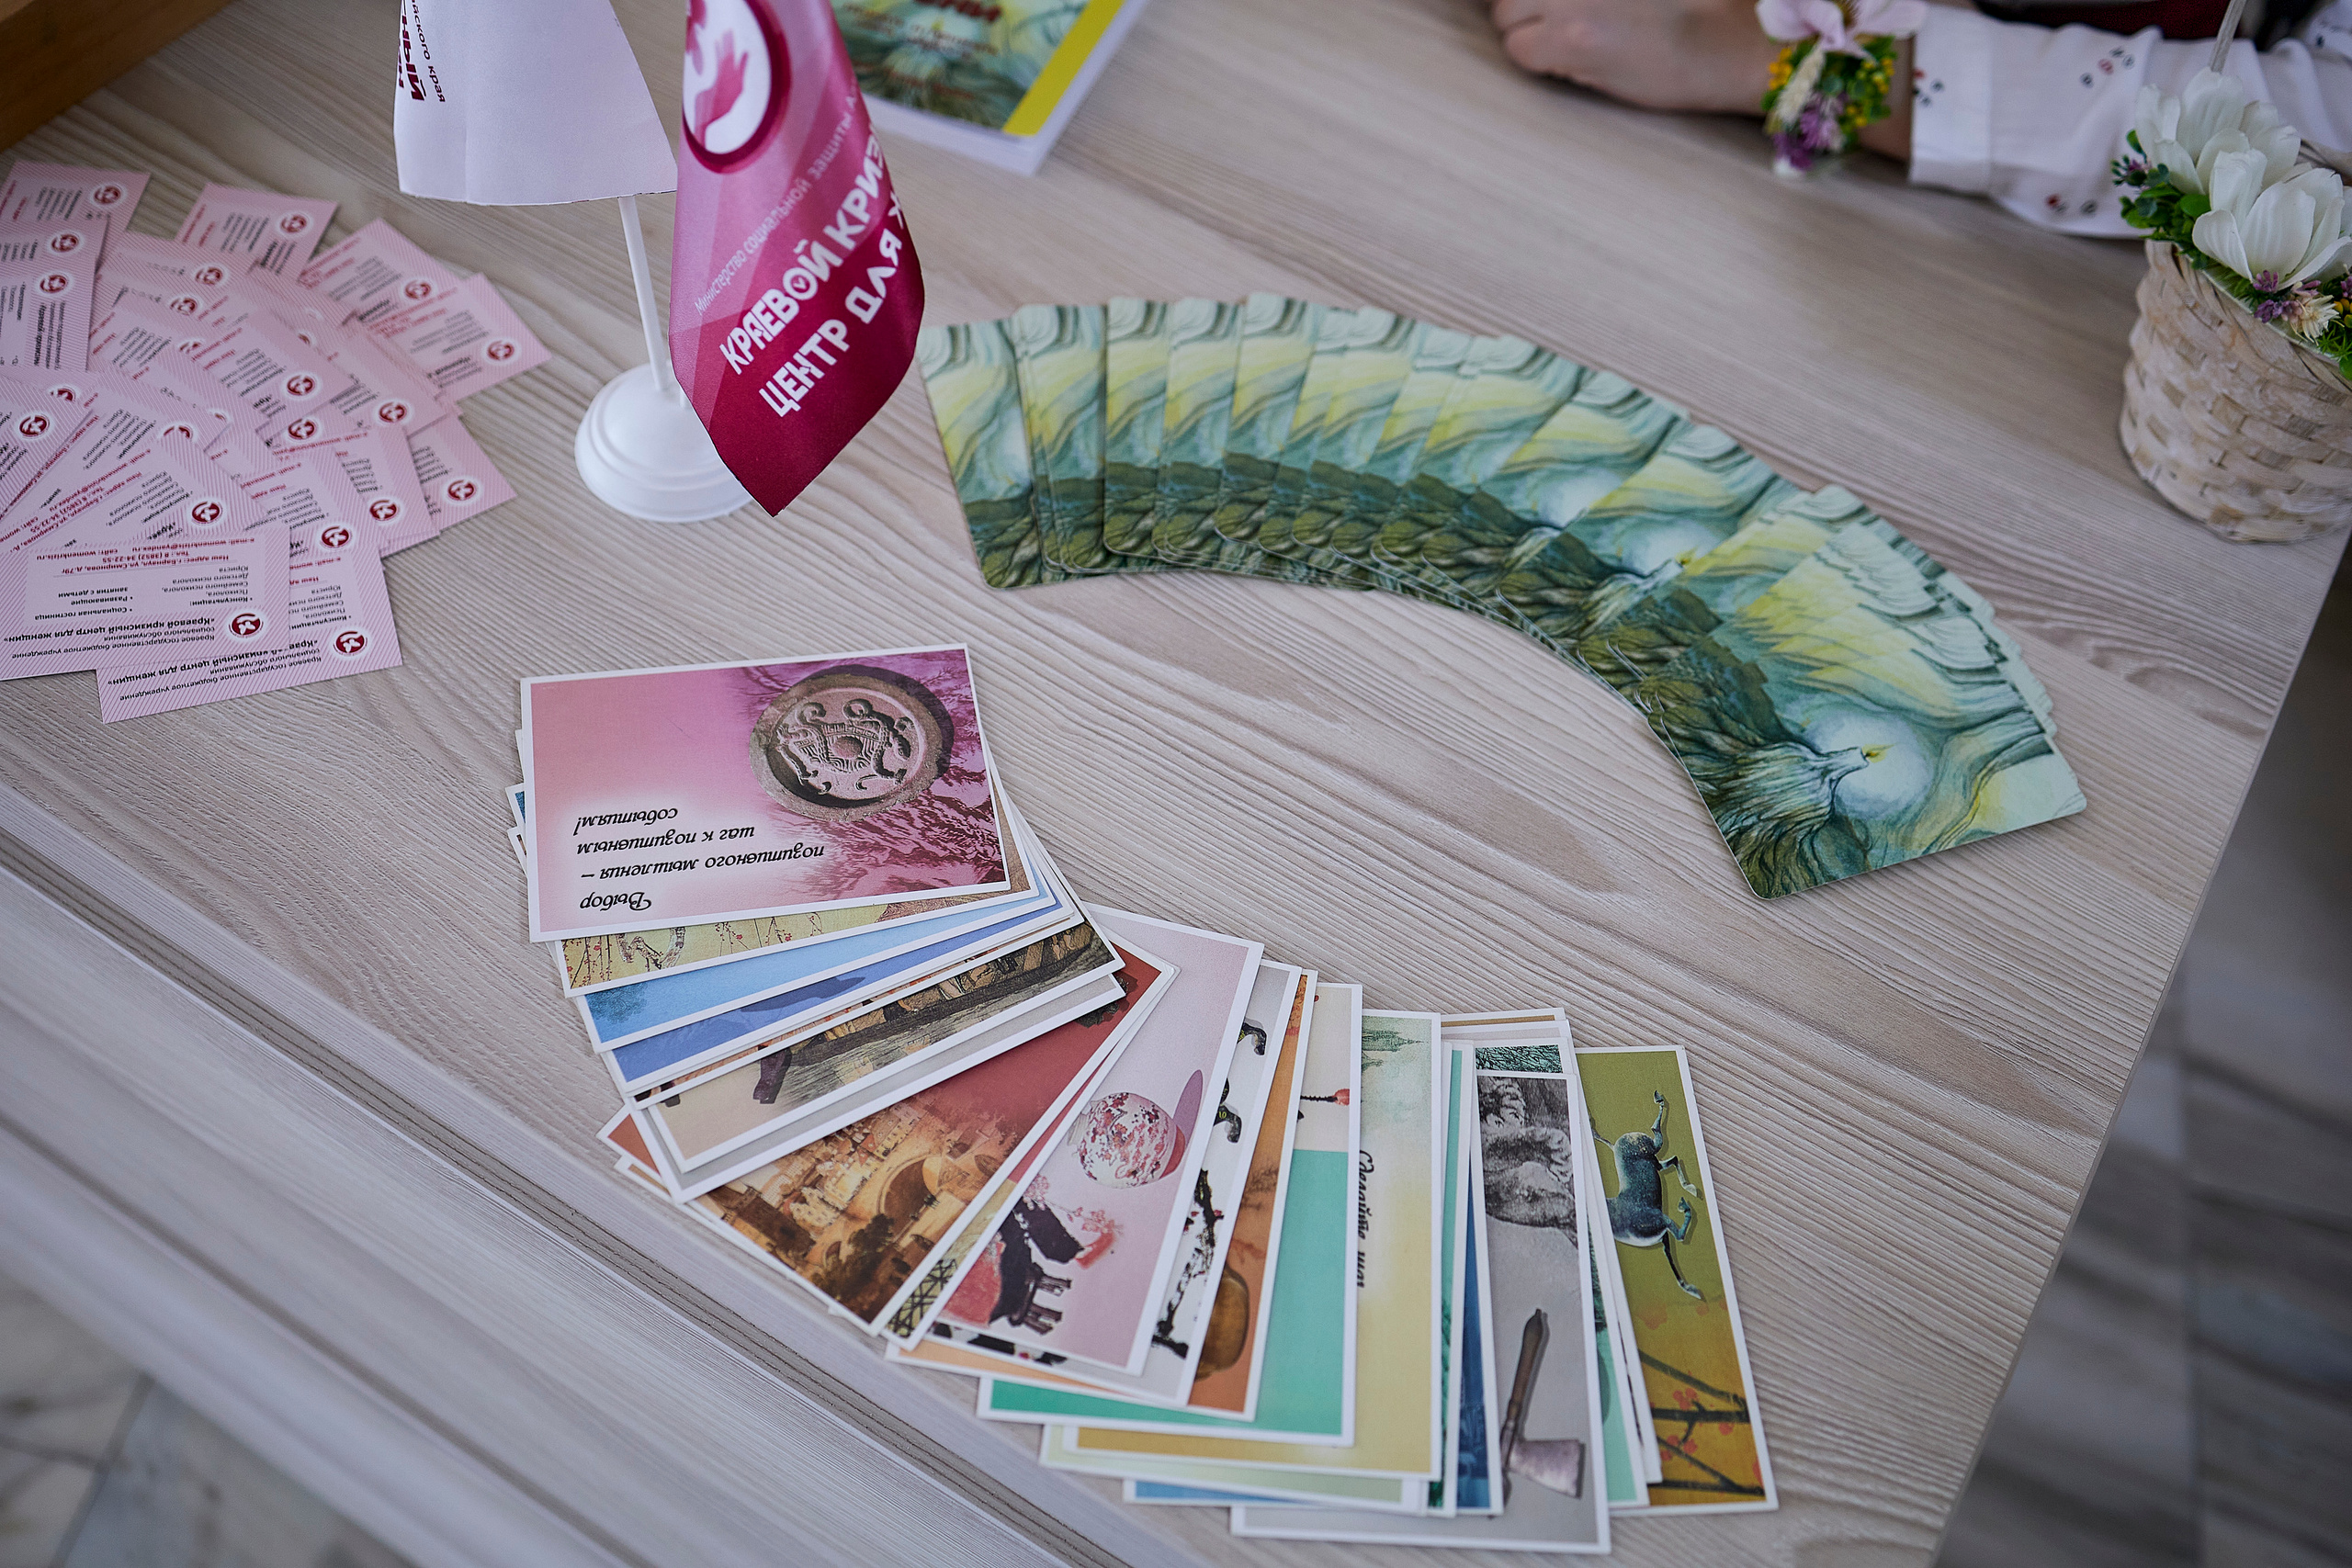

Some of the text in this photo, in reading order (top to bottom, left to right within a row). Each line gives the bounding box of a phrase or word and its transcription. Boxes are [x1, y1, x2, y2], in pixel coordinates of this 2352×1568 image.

[428, 65, 446, 102] края
[695, 112, 854, 316] Министерство социальной защиты
[718, 239, 843, 375] КРАЕВОЙ
[759, 228, 903, 417] ЦЕНТР ДЛЯ
[58, 589, 88, 597] детьми
[96, 585, 128, 594] занятия
[70, 594, 127, 606] Развивающие
[34, 605, 127, 620] Социальная гостиница
[54, 628, 74, 637] для
[75, 626, 105, 636] центр
[103, 626, 215, 642] социального обслуживания
[107, 620, 164, 634] кризисный
[3, 631, 51, 643] женщин»
[11, 633, 214, 659] Краевое государственное бюджетное учреждение
[157, 665, 178, 676] для
[179, 660, 210, 672] центр
[119, 685, 170, 701] учреждение
[573, 807, 678, 836] событиям!
[576, 826, 755, 857] шаг к позитивным
[705, 841, 825, 870] позитивного
[600, 858, 699, 882] мышления
[580, 890, 651, 912] Выбор
